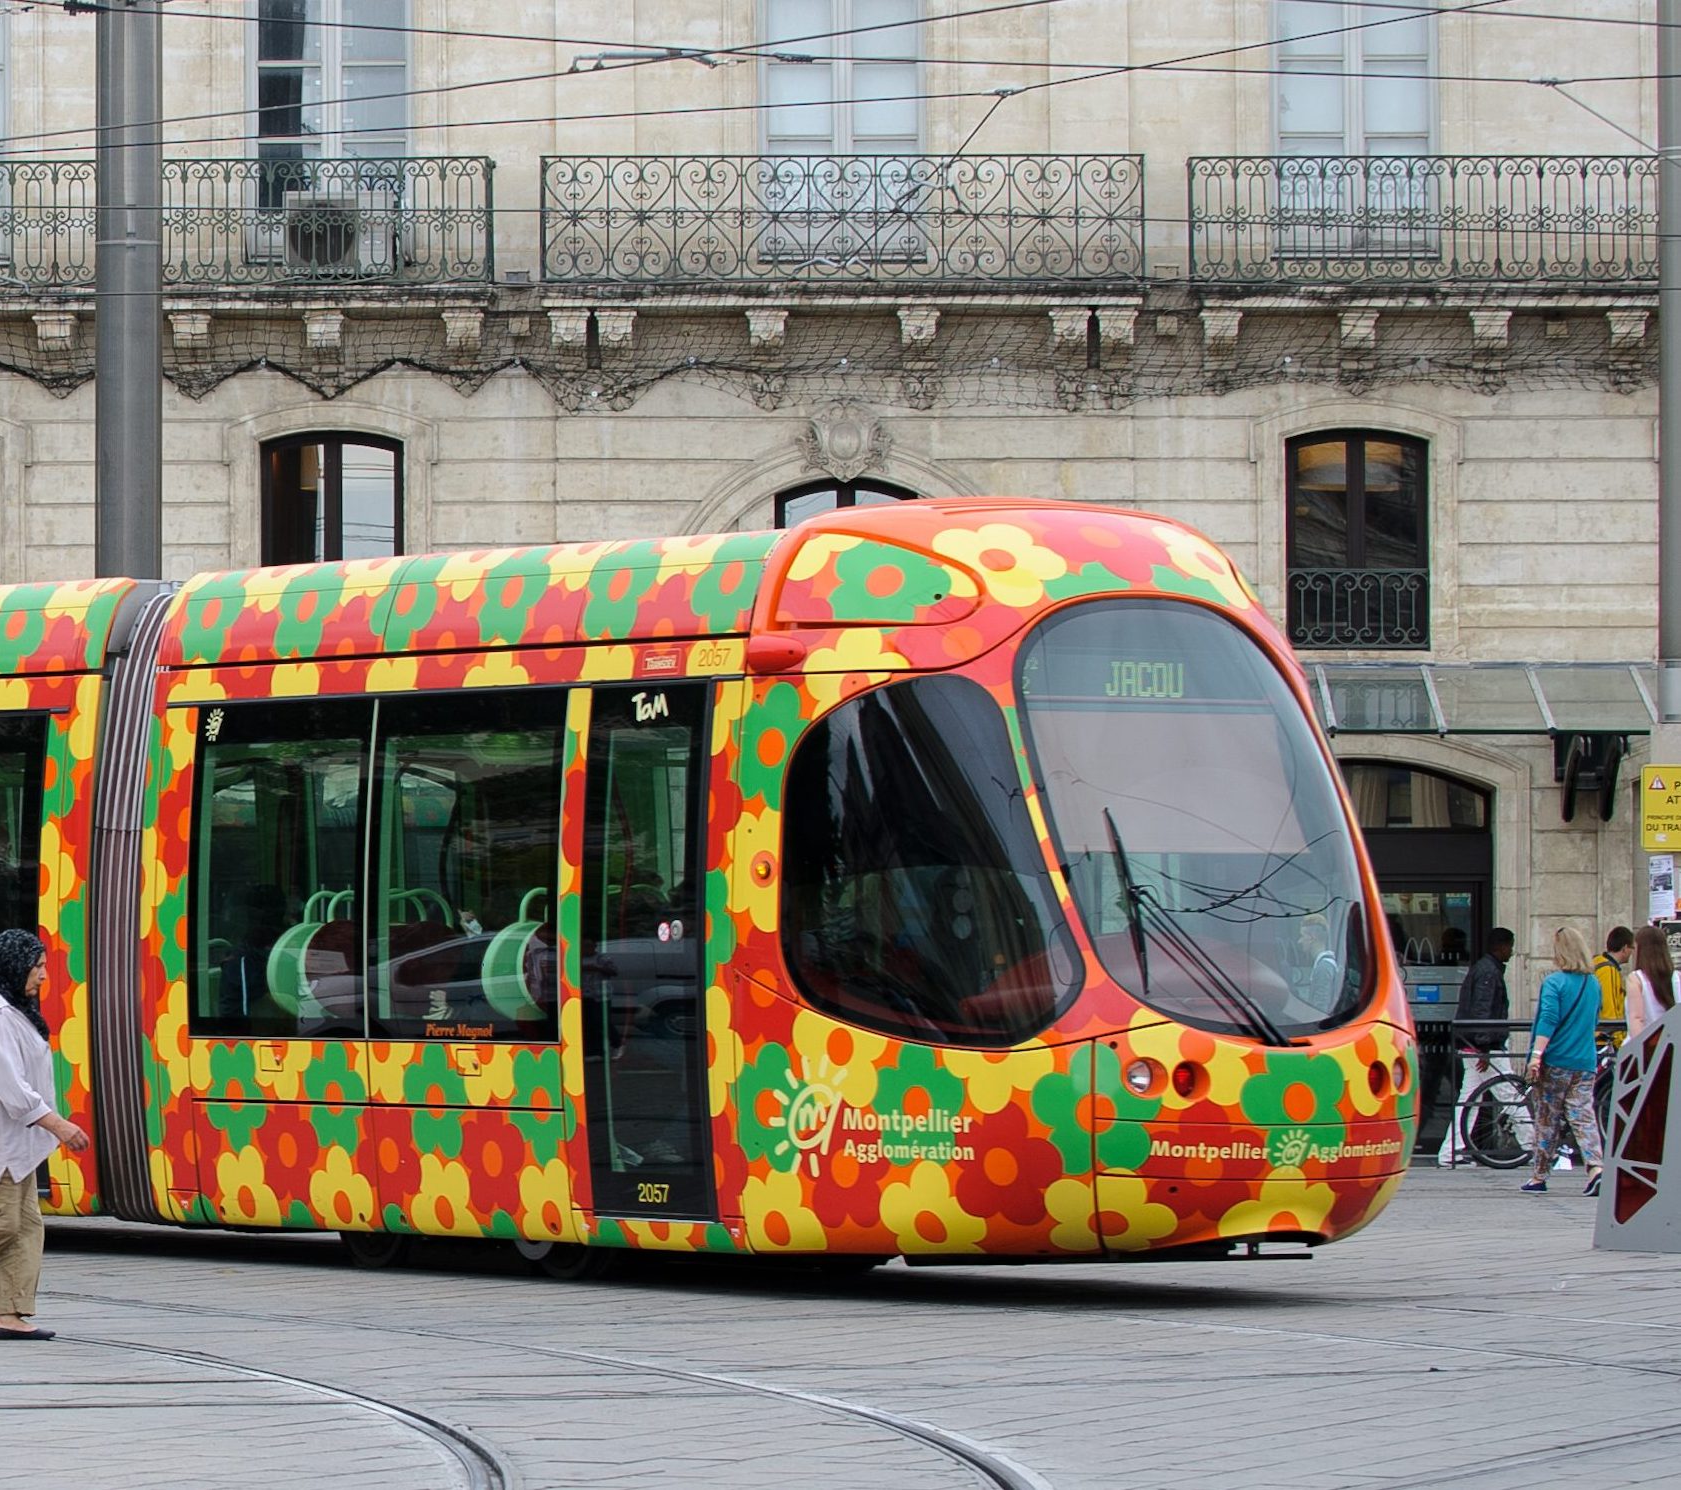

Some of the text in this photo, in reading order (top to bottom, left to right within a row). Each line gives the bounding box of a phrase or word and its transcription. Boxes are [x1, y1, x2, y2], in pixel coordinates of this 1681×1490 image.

[697, 648, 732, 668] 2057
[1105, 661, 1184, 698] JACOU
[1645, 823, 1681, 832] DU TRA
[424, 1023, 494, 1041] Pierre Magnol
[842, 1107, 974, 1139] Montpellier
[843, 1139, 975, 1164] Agglomération
[1150, 1140, 1270, 1162] Montpellier
[1307, 1138, 1402, 1163] Agglomération
[637, 1182, 670, 1204] 2057
